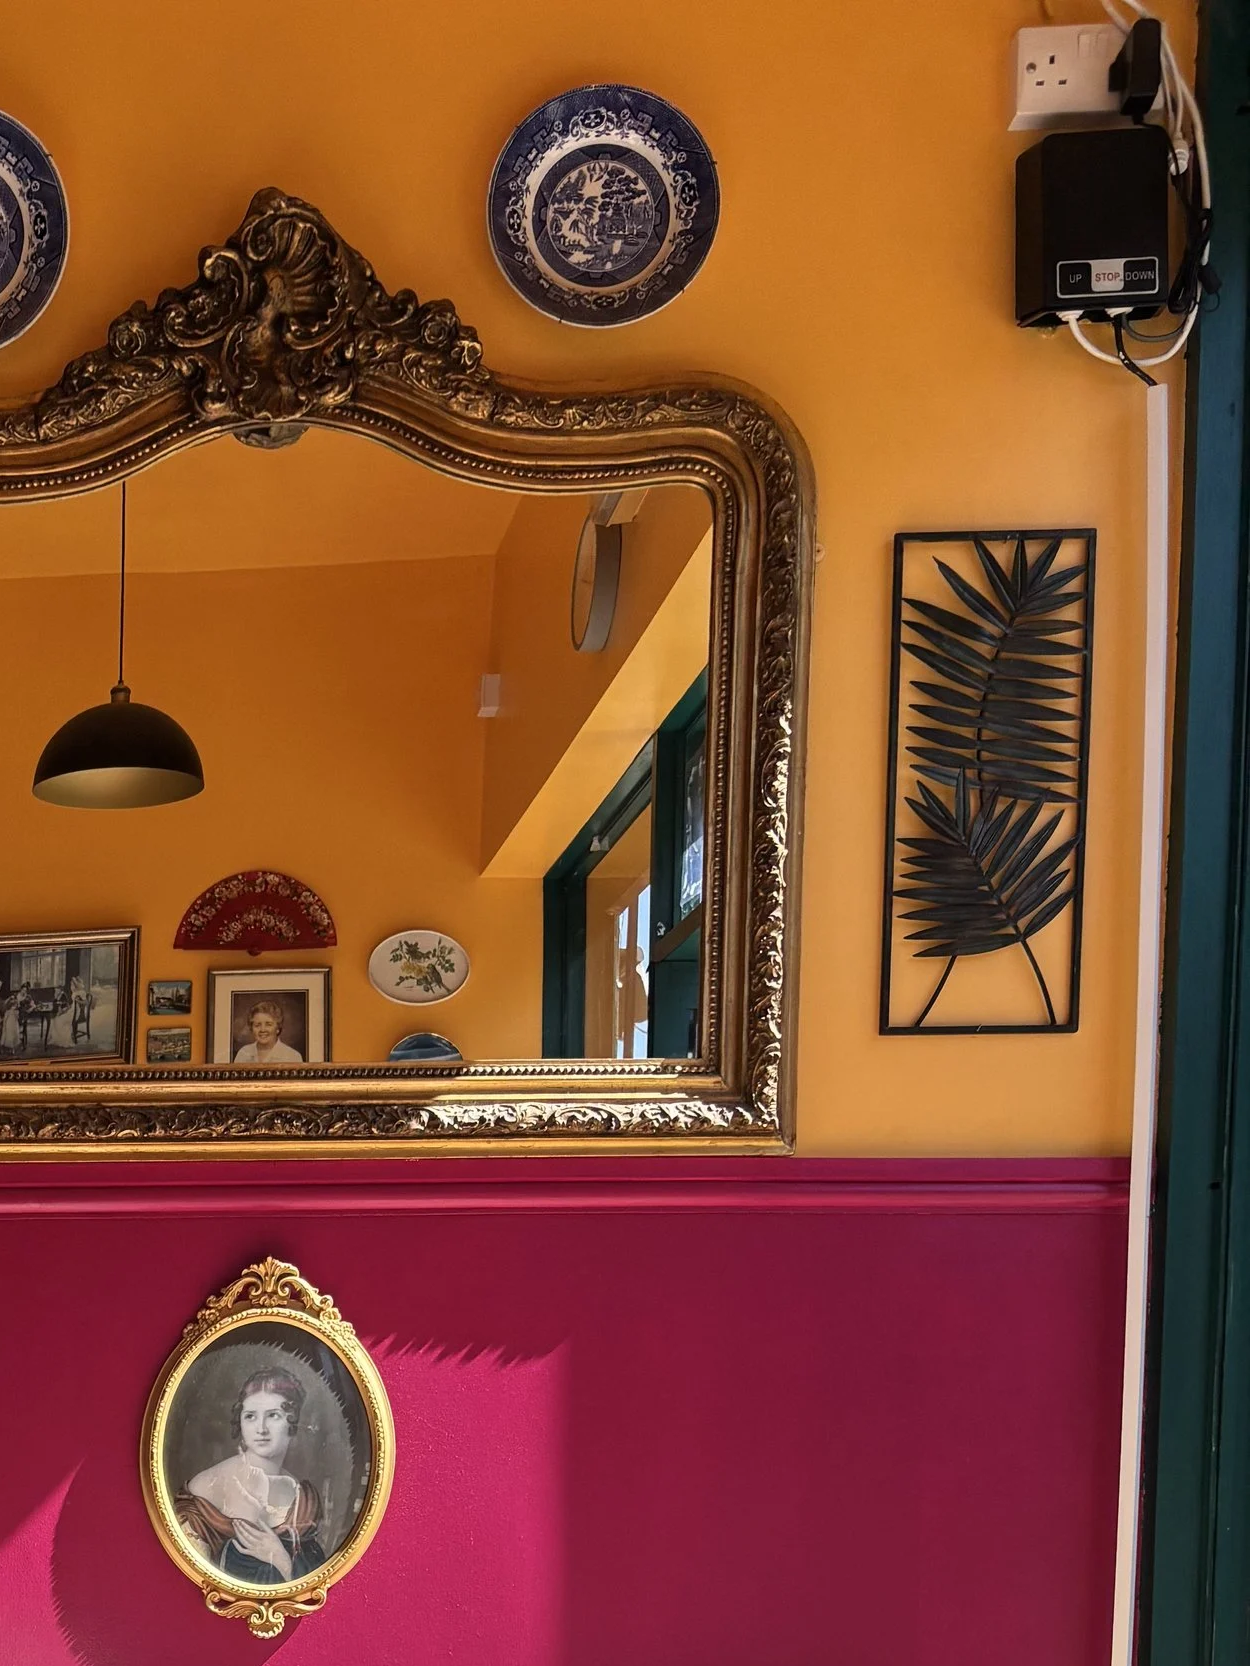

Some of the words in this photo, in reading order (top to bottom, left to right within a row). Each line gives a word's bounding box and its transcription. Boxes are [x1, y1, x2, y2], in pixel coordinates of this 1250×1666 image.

[1069, 273, 1082, 283] UP
[1095, 272, 1121, 282] STOP
[1125, 271, 1155, 280] DOWN
